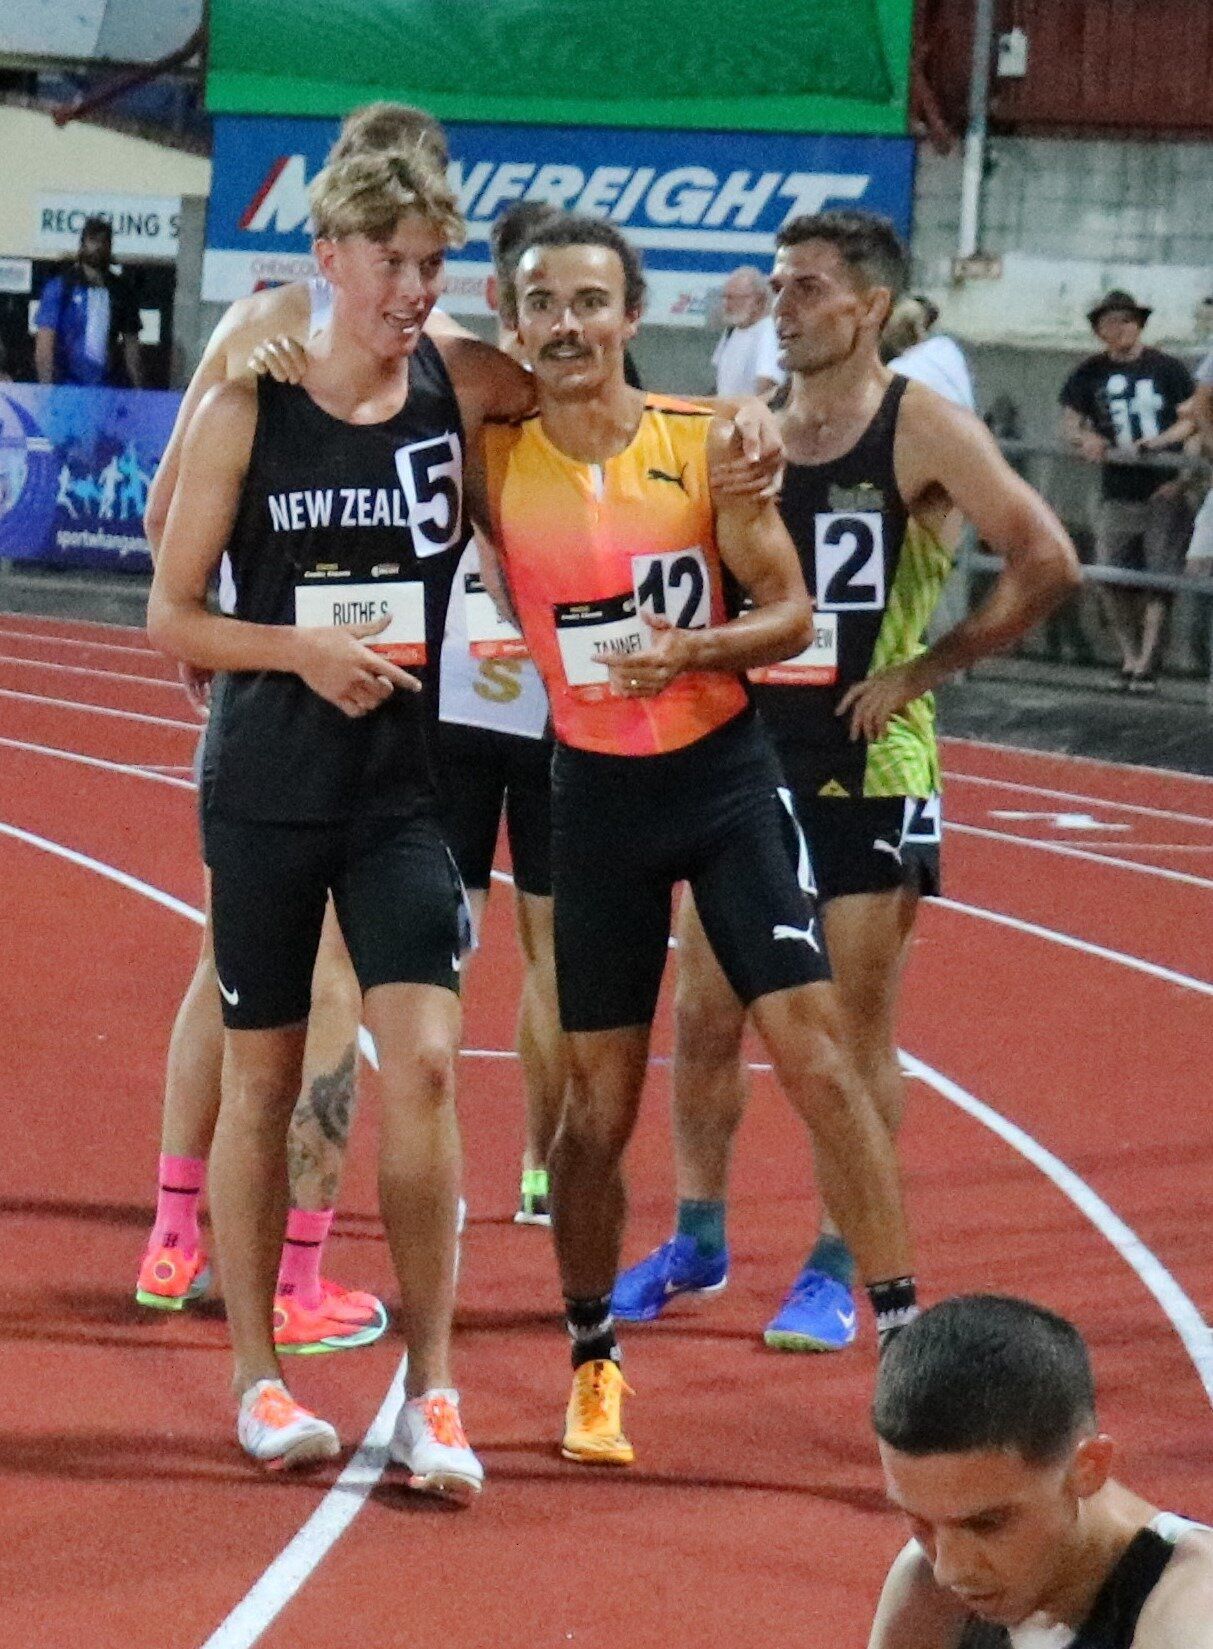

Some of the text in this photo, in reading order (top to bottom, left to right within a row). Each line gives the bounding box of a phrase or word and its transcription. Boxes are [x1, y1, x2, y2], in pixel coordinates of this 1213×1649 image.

[41, 207, 161, 236] RECLING
[240, 154, 870, 232] MNFREIGHT
[268, 487, 411, 532] NEW ZEAL
[408, 441, 455, 544] 5
[637, 555, 704, 630] 12
[823, 516, 876, 603] 2
